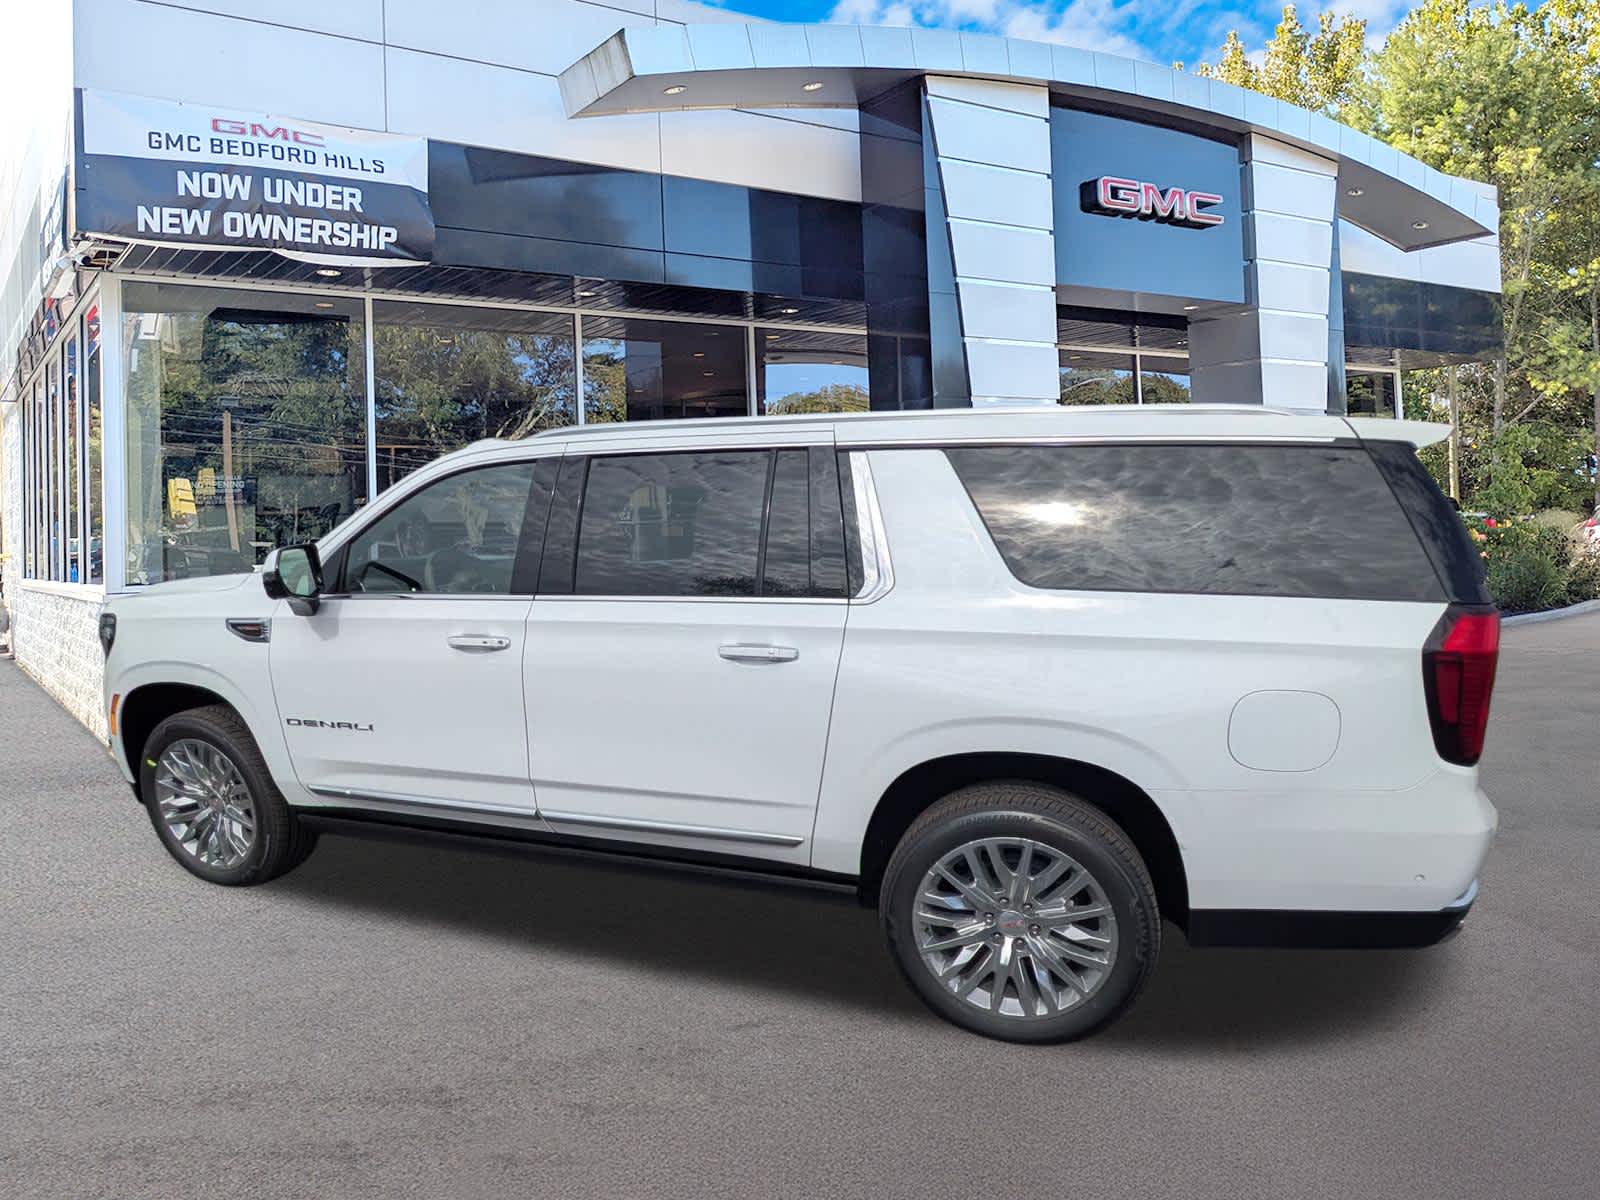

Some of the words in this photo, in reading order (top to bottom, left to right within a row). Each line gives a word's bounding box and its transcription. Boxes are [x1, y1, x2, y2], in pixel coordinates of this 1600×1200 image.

[148, 131, 201, 152] GMC
[210, 138, 317, 165] BEDFORD
[324, 152, 385, 174] HILLS
[212, 118, 326, 147] GMC
[177, 170, 252, 201] NOW
[263, 176, 363, 212] UNDER
[1097, 175, 1225, 224] GMC
[136, 206, 211, 235] NEW
[223, 211, 398, 250] OWNERSHIP
[286, 718, 374, 732] DENALI
